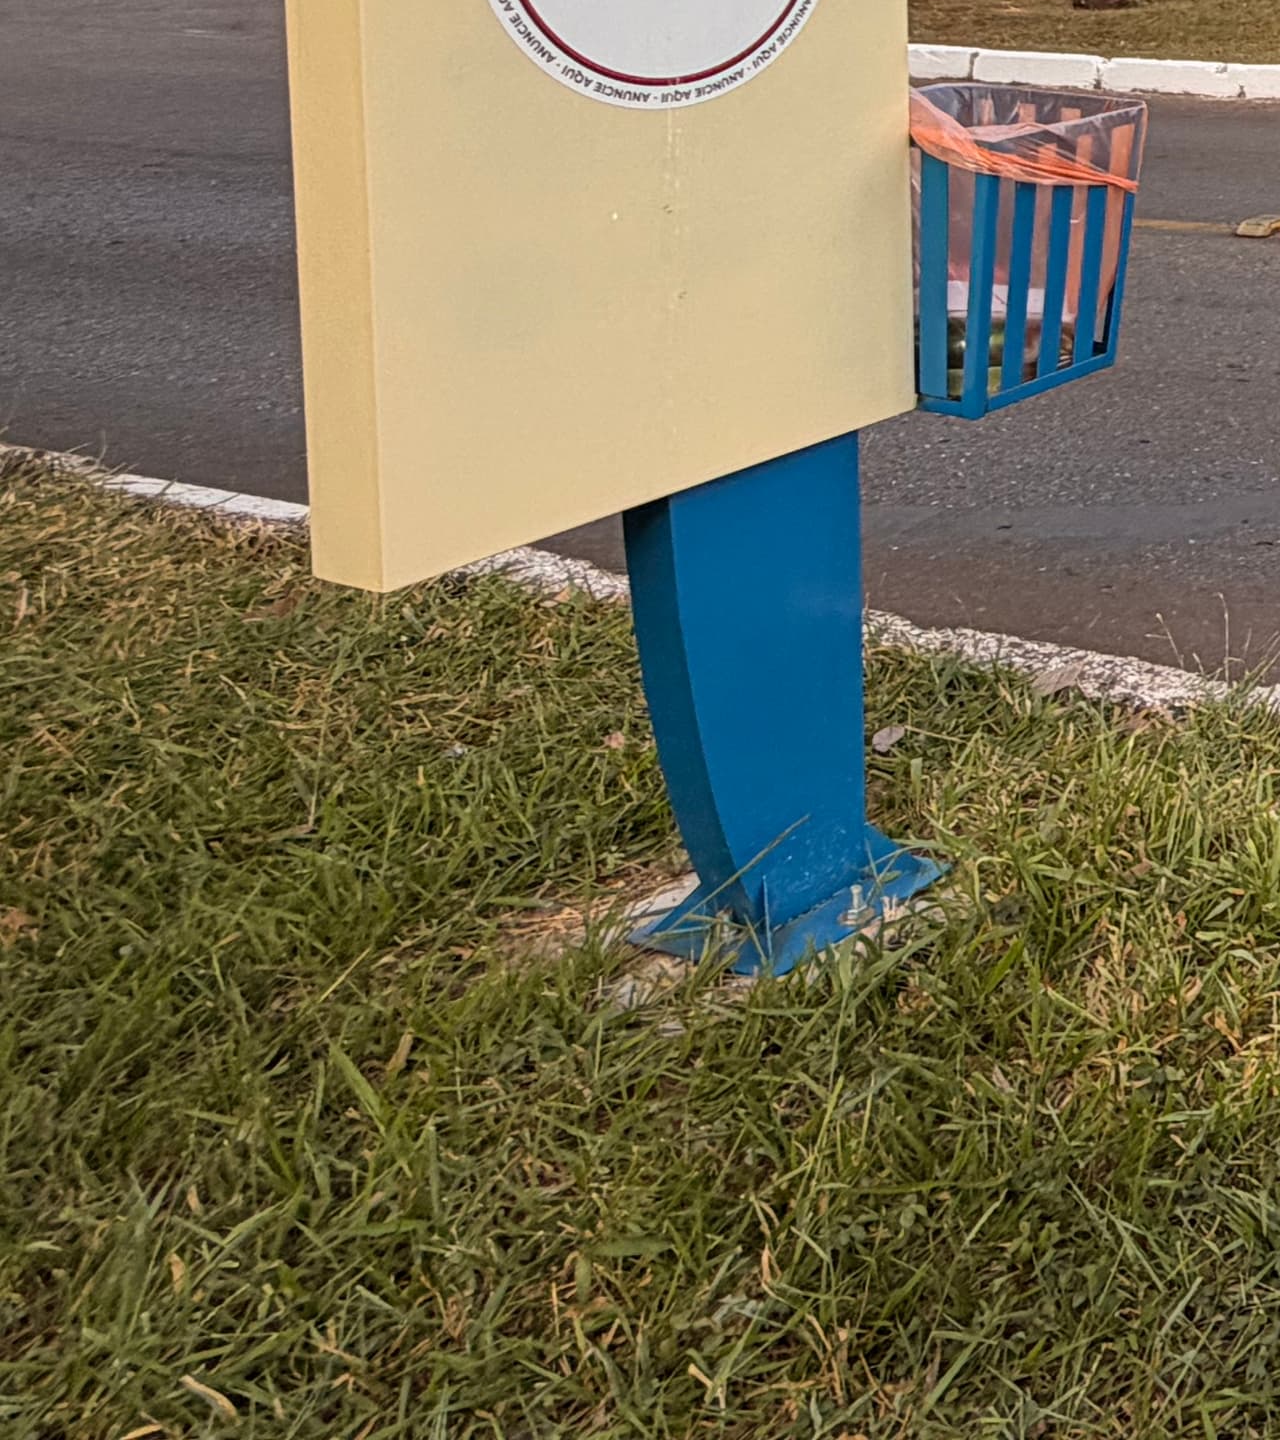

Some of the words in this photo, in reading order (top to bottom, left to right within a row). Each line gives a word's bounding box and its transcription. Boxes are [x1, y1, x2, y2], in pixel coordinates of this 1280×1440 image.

[508, 12, 557, 64] ANUNCIE
[560, 64, 594, 88] AQUI
[592, 81, 651, 103] ANUNCIE
